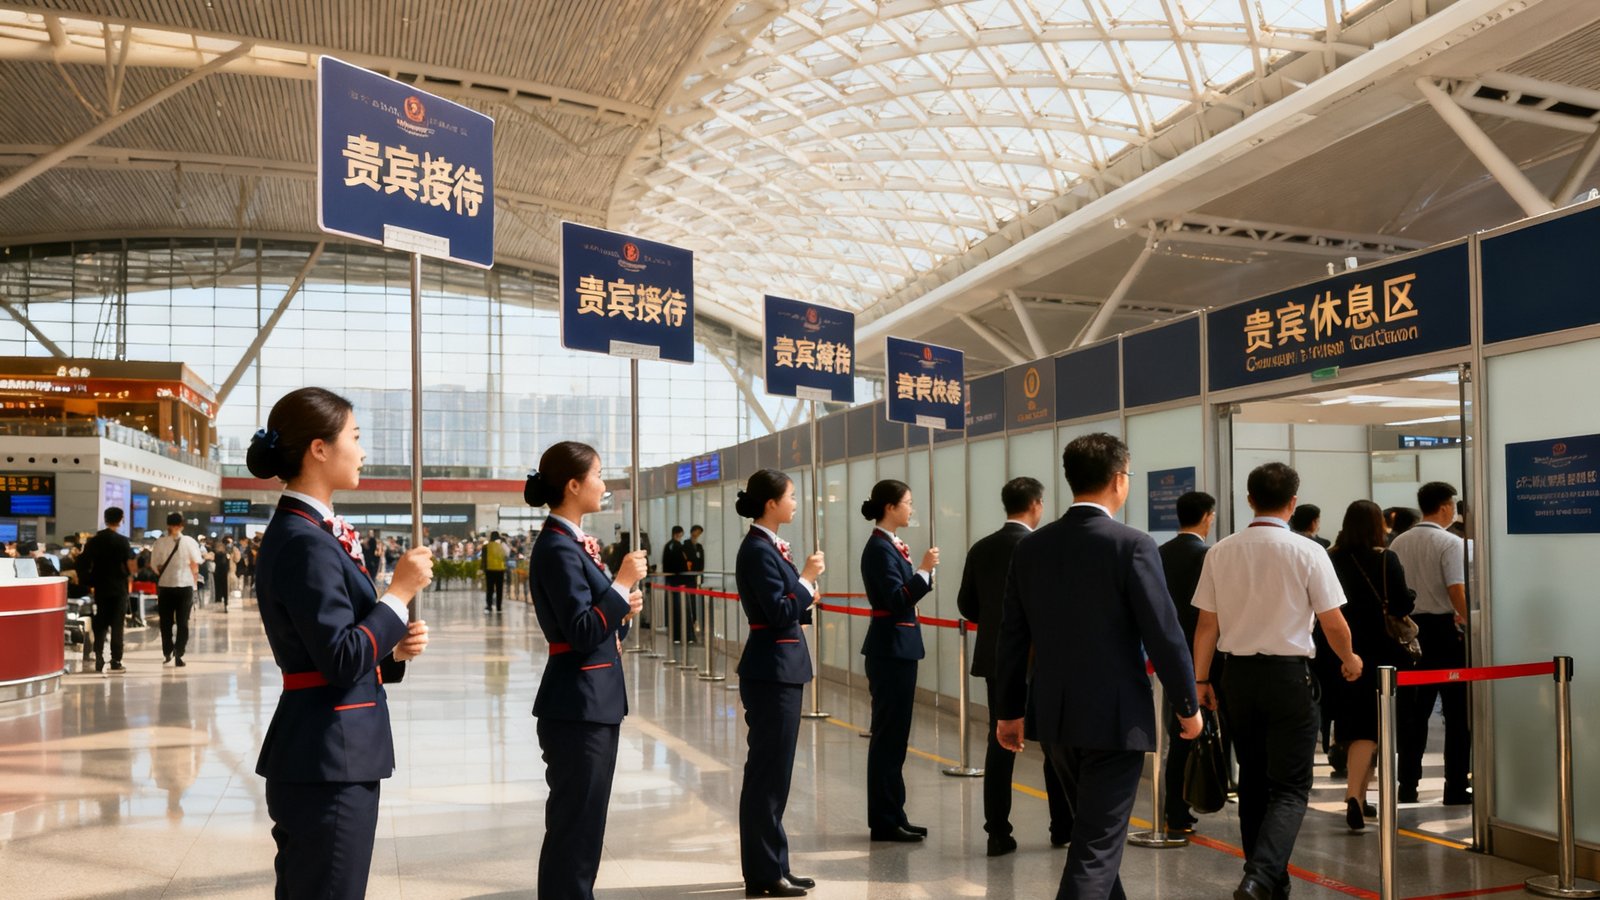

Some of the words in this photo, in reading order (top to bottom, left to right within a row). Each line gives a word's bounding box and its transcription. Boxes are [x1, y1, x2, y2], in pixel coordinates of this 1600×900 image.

[342, 133, 485, 217] 贵宾接待
[575, 274, 688, 327] 贵宾接待
[1243, 273, 1420, 354] 贵宾休息区
